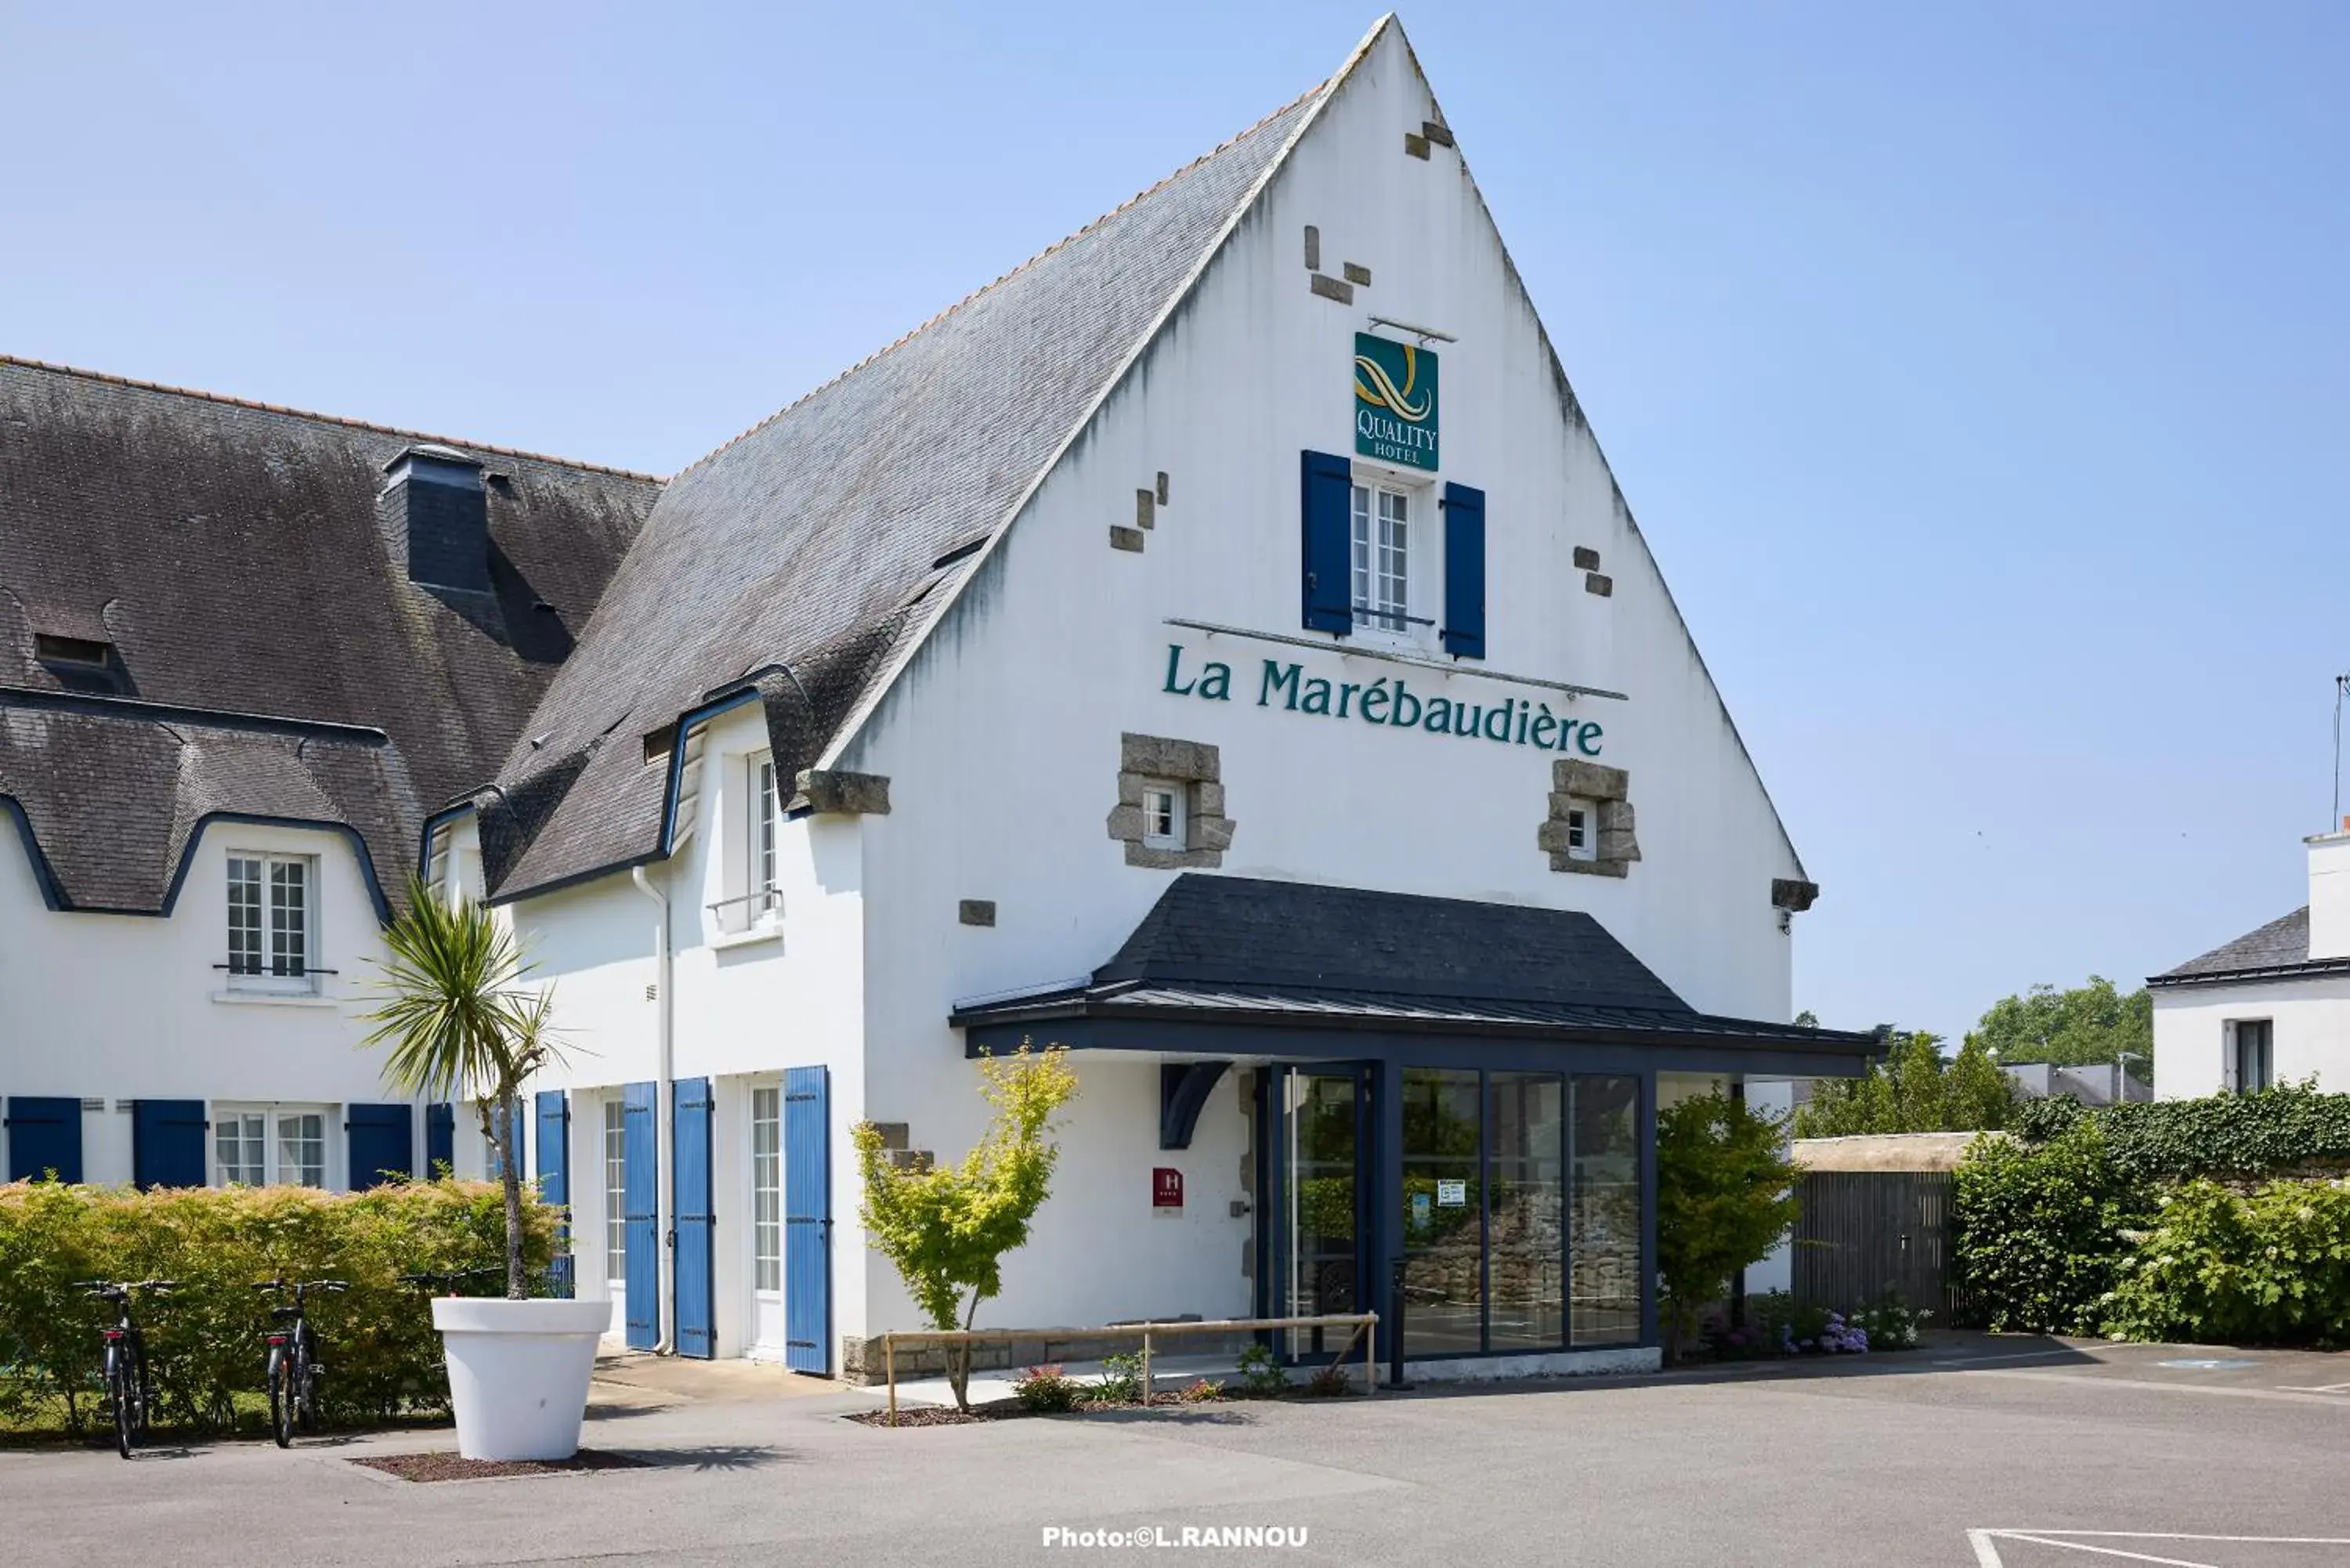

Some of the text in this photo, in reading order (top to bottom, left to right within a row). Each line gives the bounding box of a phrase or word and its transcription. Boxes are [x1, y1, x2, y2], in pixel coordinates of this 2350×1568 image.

[1358, 410, 1437, 450] QUALITY
[1375, 442, 1420, 464] HOTEL
[1162, 645, 1603, 756] La Marébaudière
[1166, 1174, 1179, 1190] H
